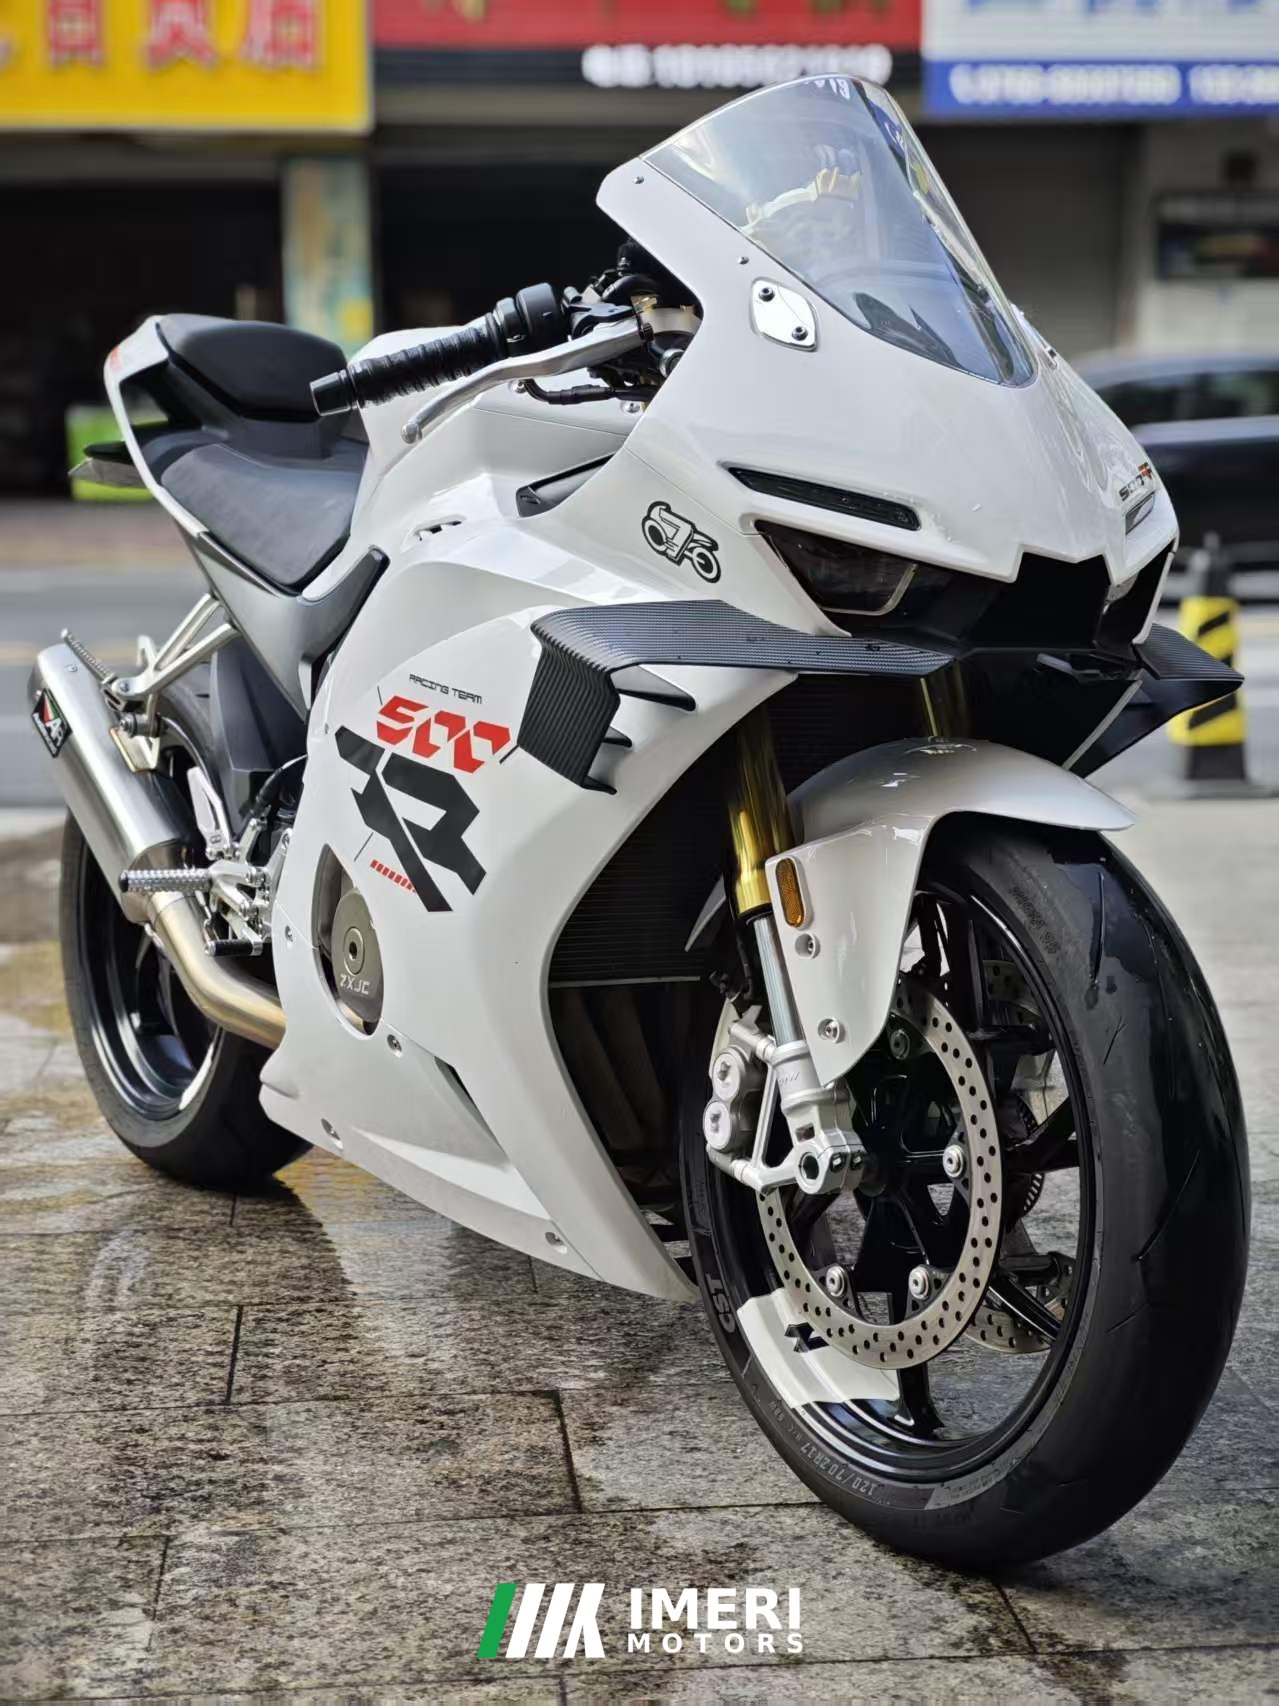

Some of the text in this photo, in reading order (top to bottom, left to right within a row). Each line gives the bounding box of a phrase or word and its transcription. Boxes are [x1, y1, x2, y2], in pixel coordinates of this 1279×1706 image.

[409, 674, 482, 704] RACING TEAM
[376, 695, 511, 774] 500
